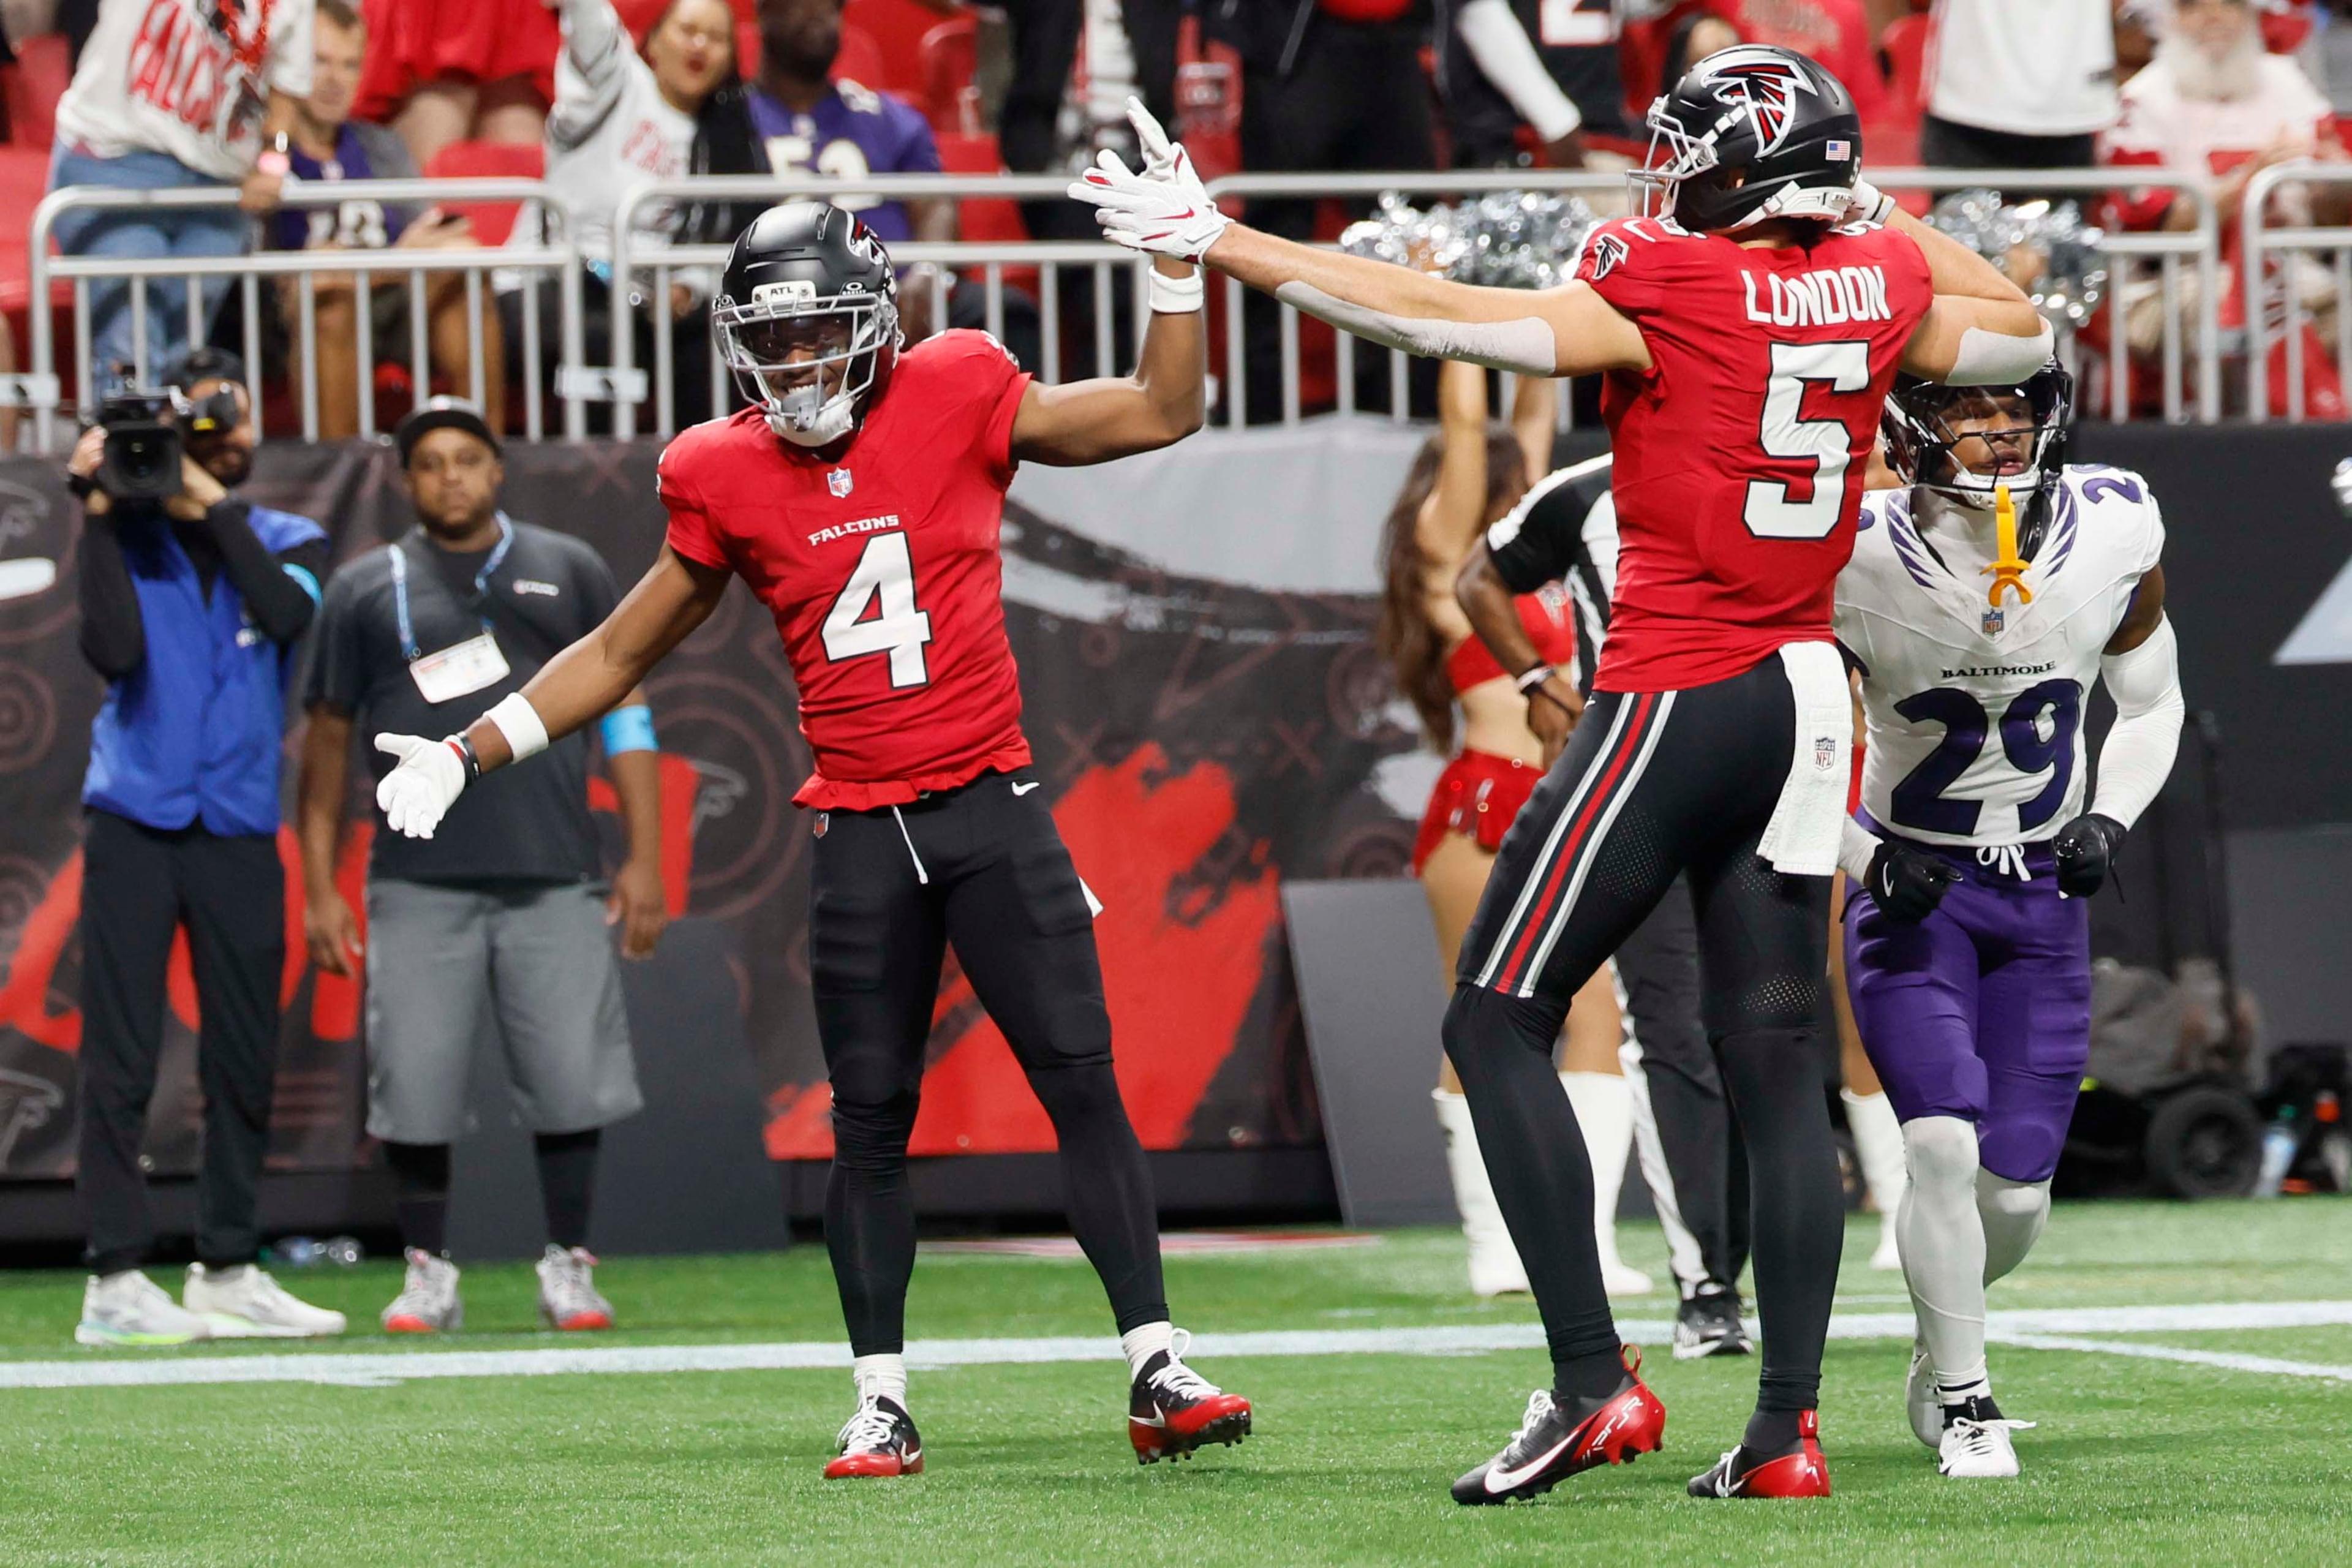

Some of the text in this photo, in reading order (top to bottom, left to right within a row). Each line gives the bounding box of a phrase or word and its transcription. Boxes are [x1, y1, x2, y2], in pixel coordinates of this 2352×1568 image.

[770, 286, 794, 295] ATL
[1741, 265, 1892, 326] LONDON
[1741, 338, 1871, 541] 5
[808, 515, 899, 546] FALCONS
[820, 530, 932, 690] 4
[1940, 660, 2056, 679] BALTIMORE
[1815, 751, 1832, 767] NFL
[1891, 678, 2084, 837] 29
